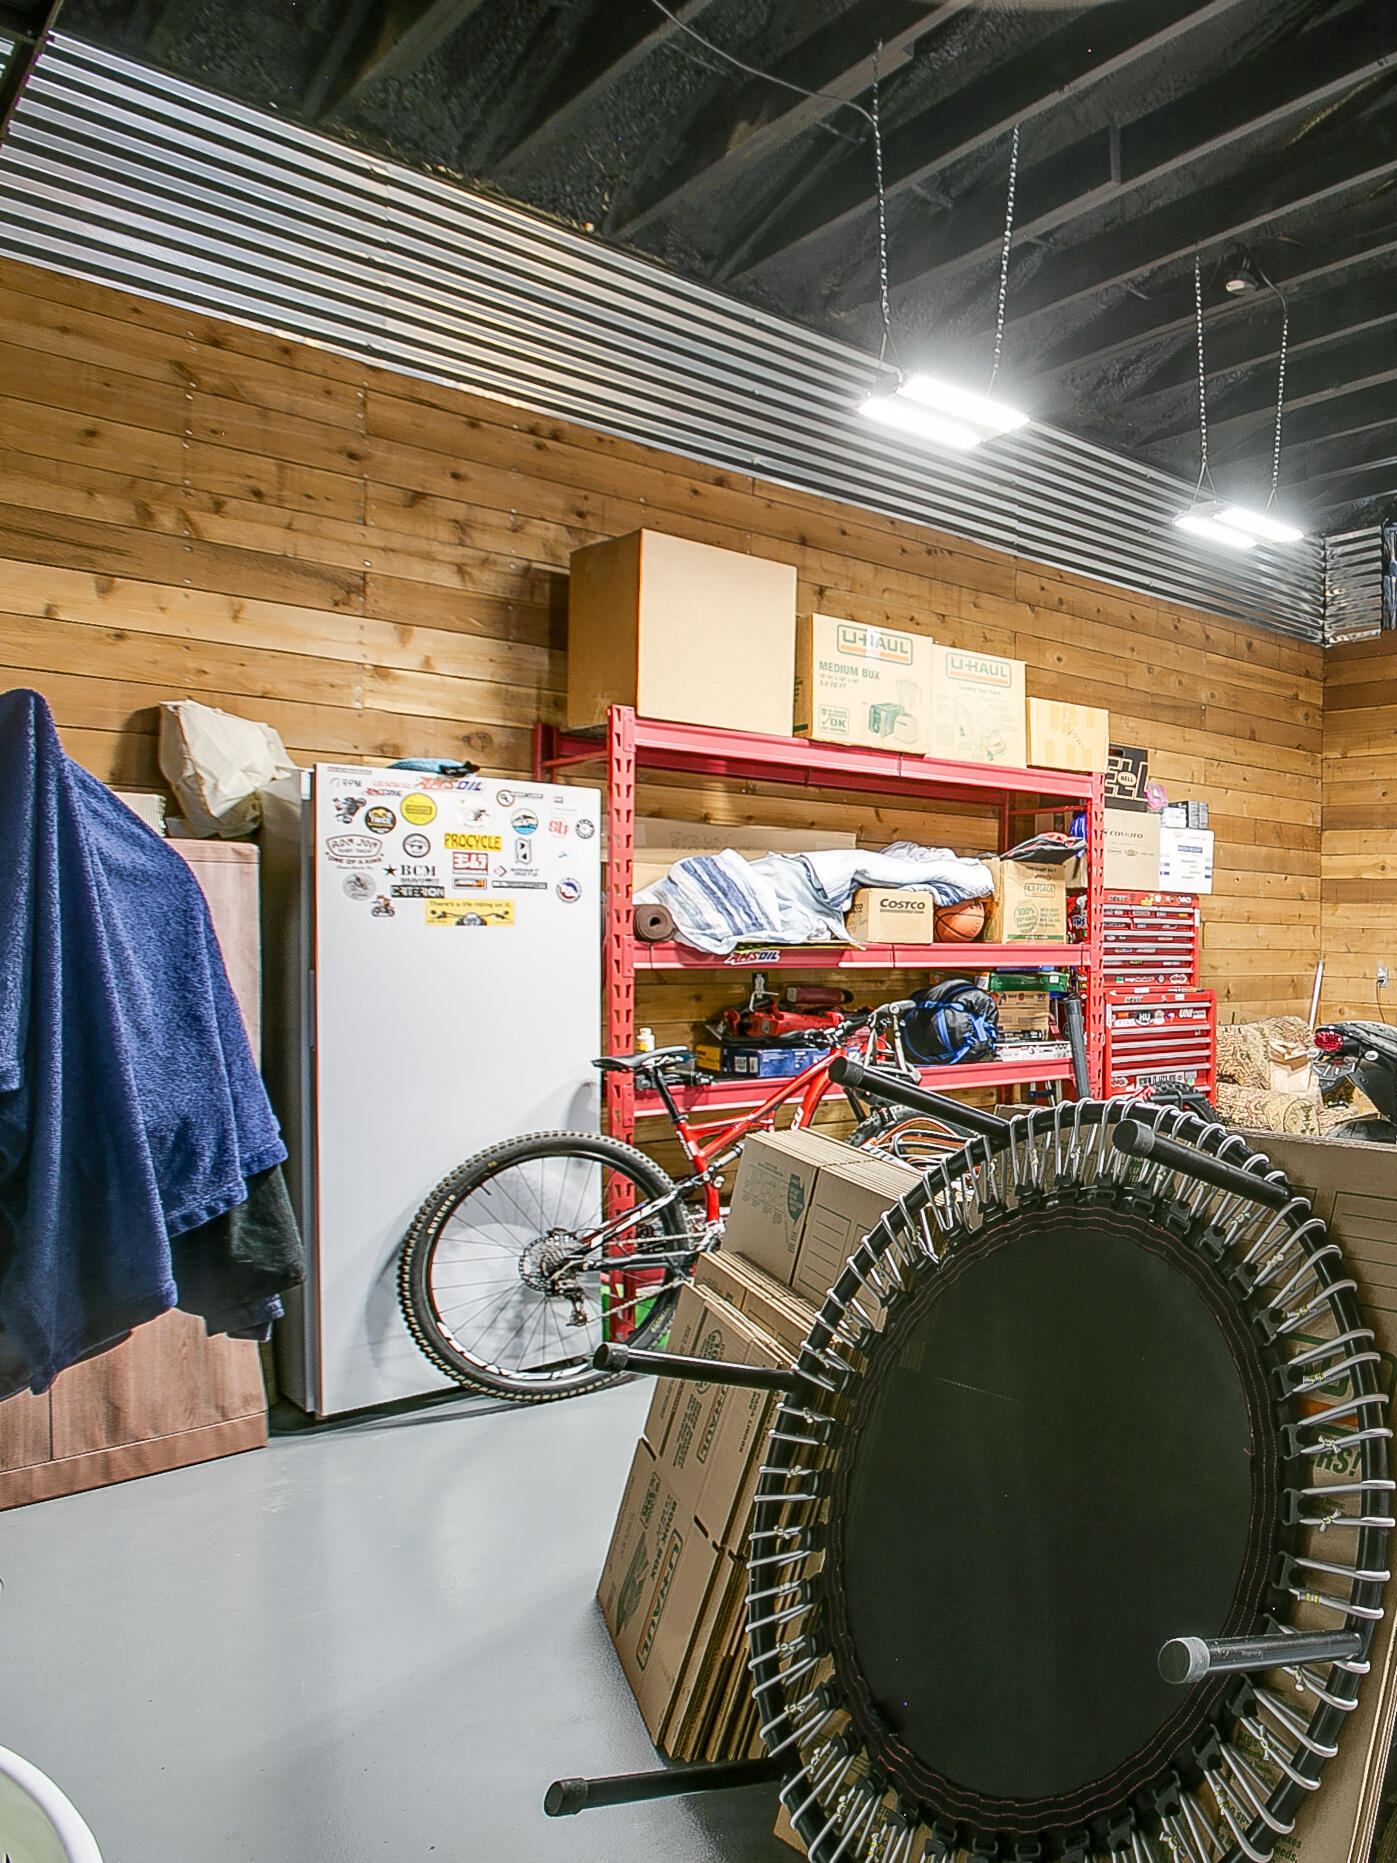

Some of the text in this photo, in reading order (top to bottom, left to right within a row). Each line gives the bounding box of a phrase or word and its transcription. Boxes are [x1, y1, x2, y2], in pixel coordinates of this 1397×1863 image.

[842, 629, 909, 654] U-HAUL
[819, 660, 858, 676] MEDIUM
[862, 667, 880, 680] BOX
[951, 657, 1008, 677] U-HAUL
[1120, 775, 1135, 783] BELL
[445, 832, 501, 850] PROCYCLE
[400, 864, 436, 877] BCM
[391, 886, 444, 897] CRITERION
[730, 951, 778, 963] AMSOIL
[639, 1540, 681, 1662] U-HAUL
